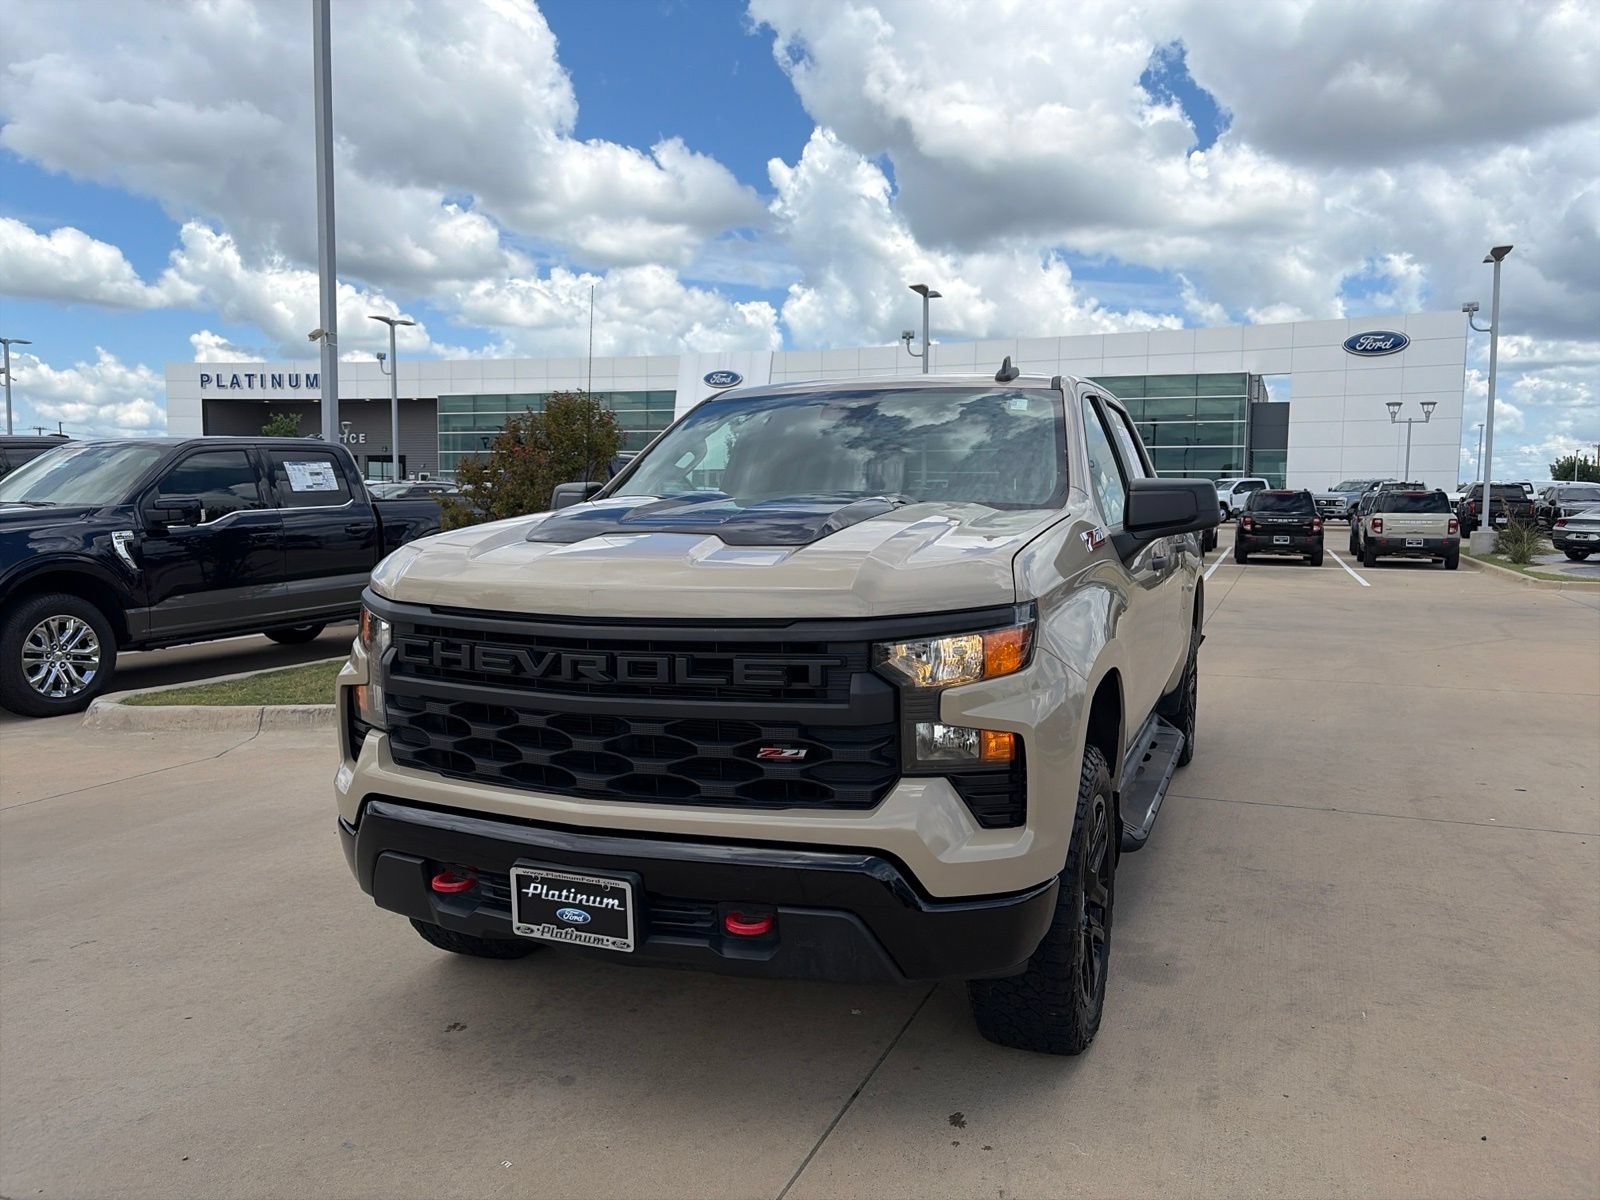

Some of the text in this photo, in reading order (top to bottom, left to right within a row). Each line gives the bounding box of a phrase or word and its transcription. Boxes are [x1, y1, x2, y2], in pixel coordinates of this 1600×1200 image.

[1355, 335, 1395, 350] Ford
[200, 373, 321, 389] PLATINUM
[710, 373, 732, 384] Ford
[396, 638, 845, 687] CHEVROLET
[521, 883, 625, 911] Platinum
[562, 910, 584, 922] Ford
[540, 924, 609, 947] Platinum
